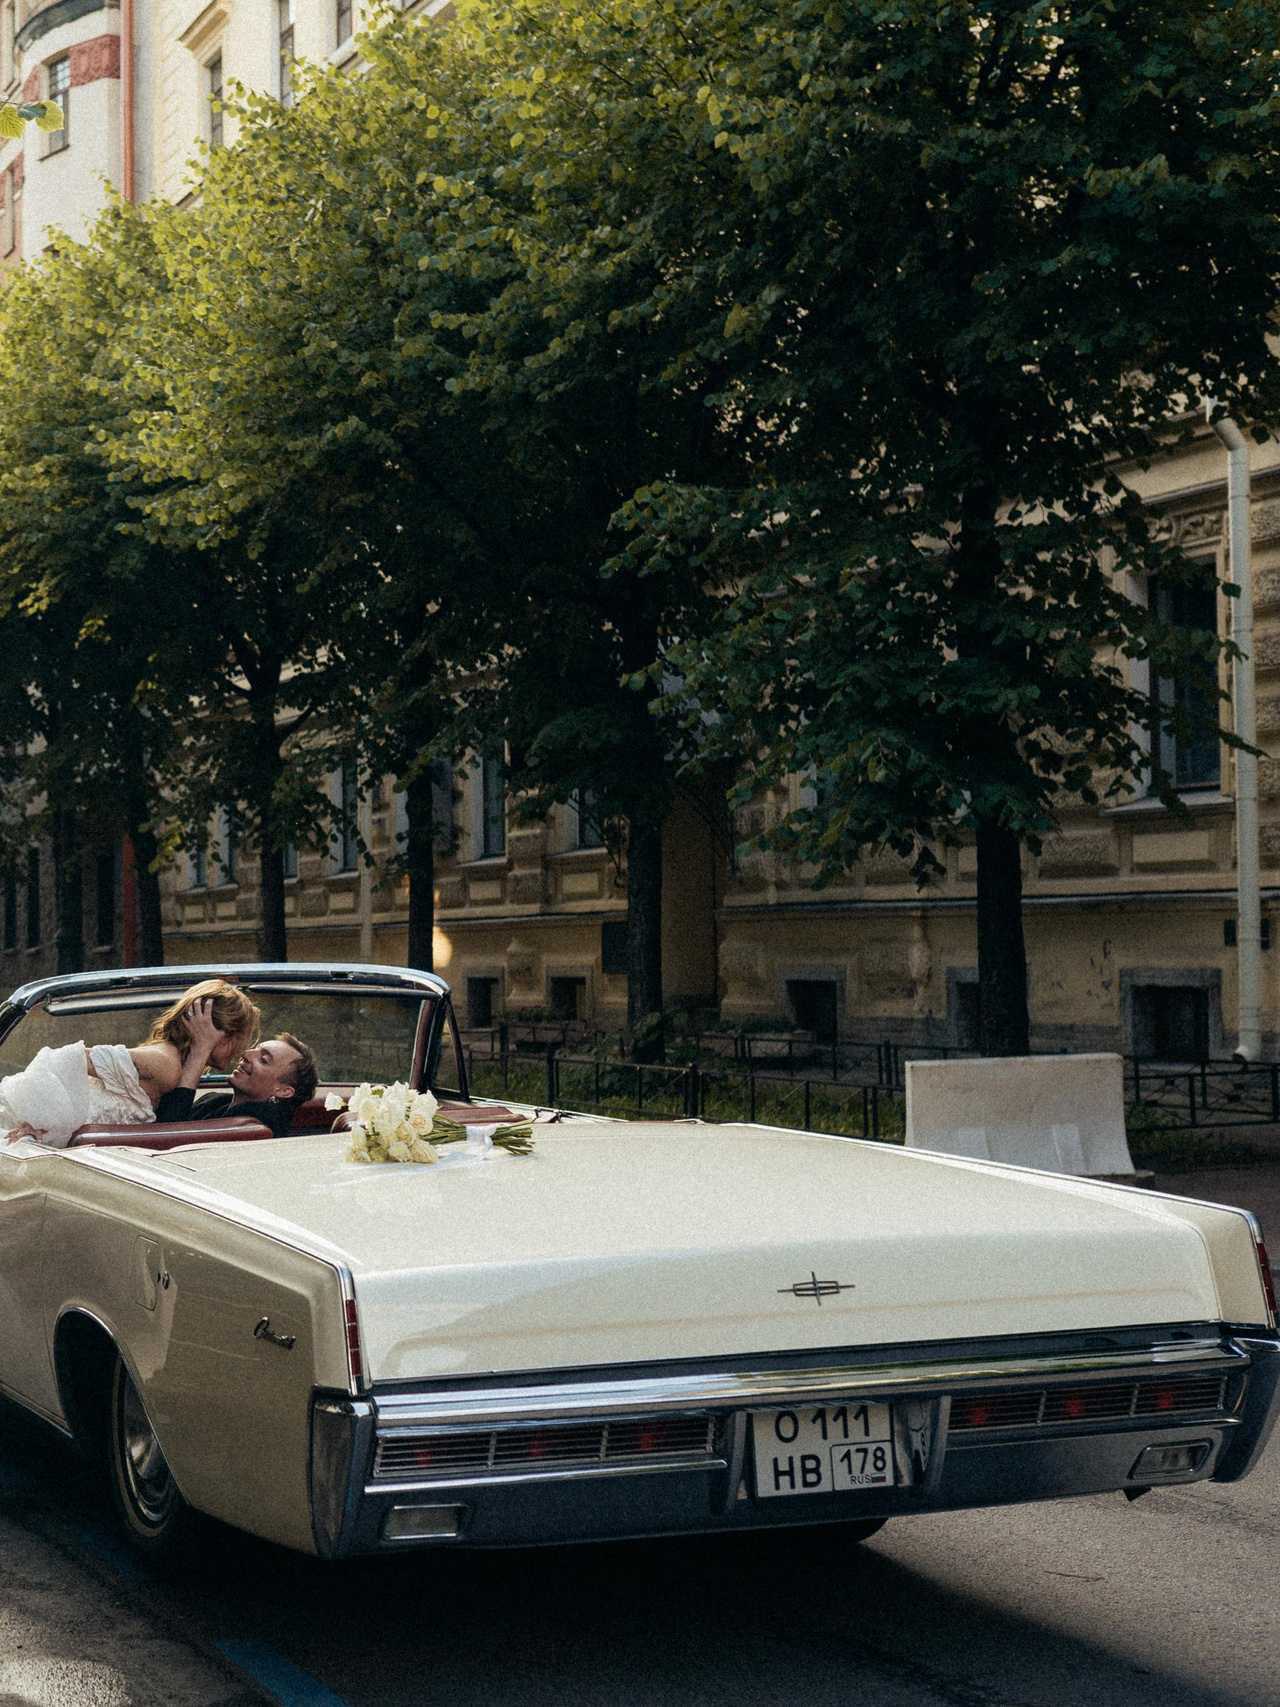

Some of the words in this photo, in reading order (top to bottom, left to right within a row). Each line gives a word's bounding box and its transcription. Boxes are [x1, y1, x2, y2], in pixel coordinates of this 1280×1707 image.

[811, 1405, 870, 1441] 111
[840, 1446, 887, 1475] 178
[850, 1474, 871, 1486] RUS
